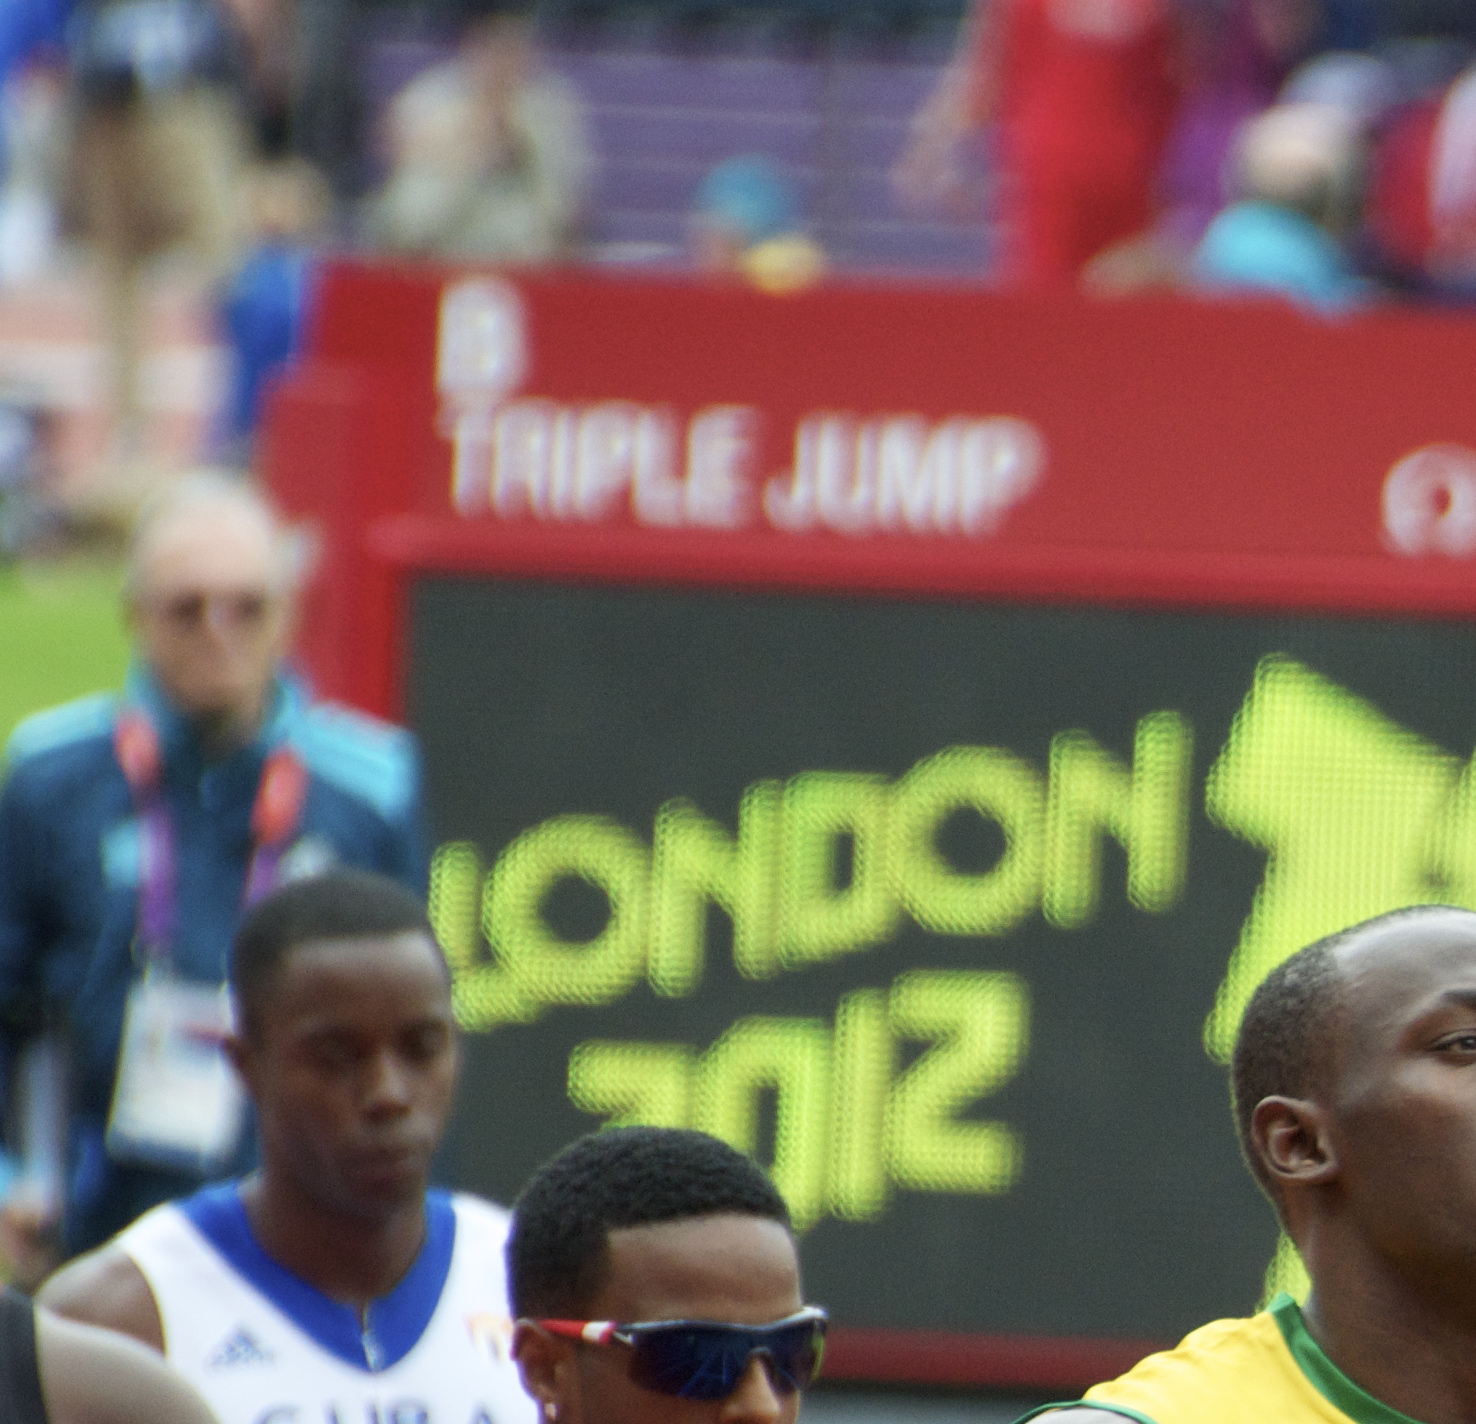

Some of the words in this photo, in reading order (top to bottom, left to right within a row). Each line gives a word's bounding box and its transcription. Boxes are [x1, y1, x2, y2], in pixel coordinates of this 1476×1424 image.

[436, 398, 754, 528] TRIPLE
[764, 410, 1048, 536] JUMP
[428, 710, 1193, 1032] LONDON
